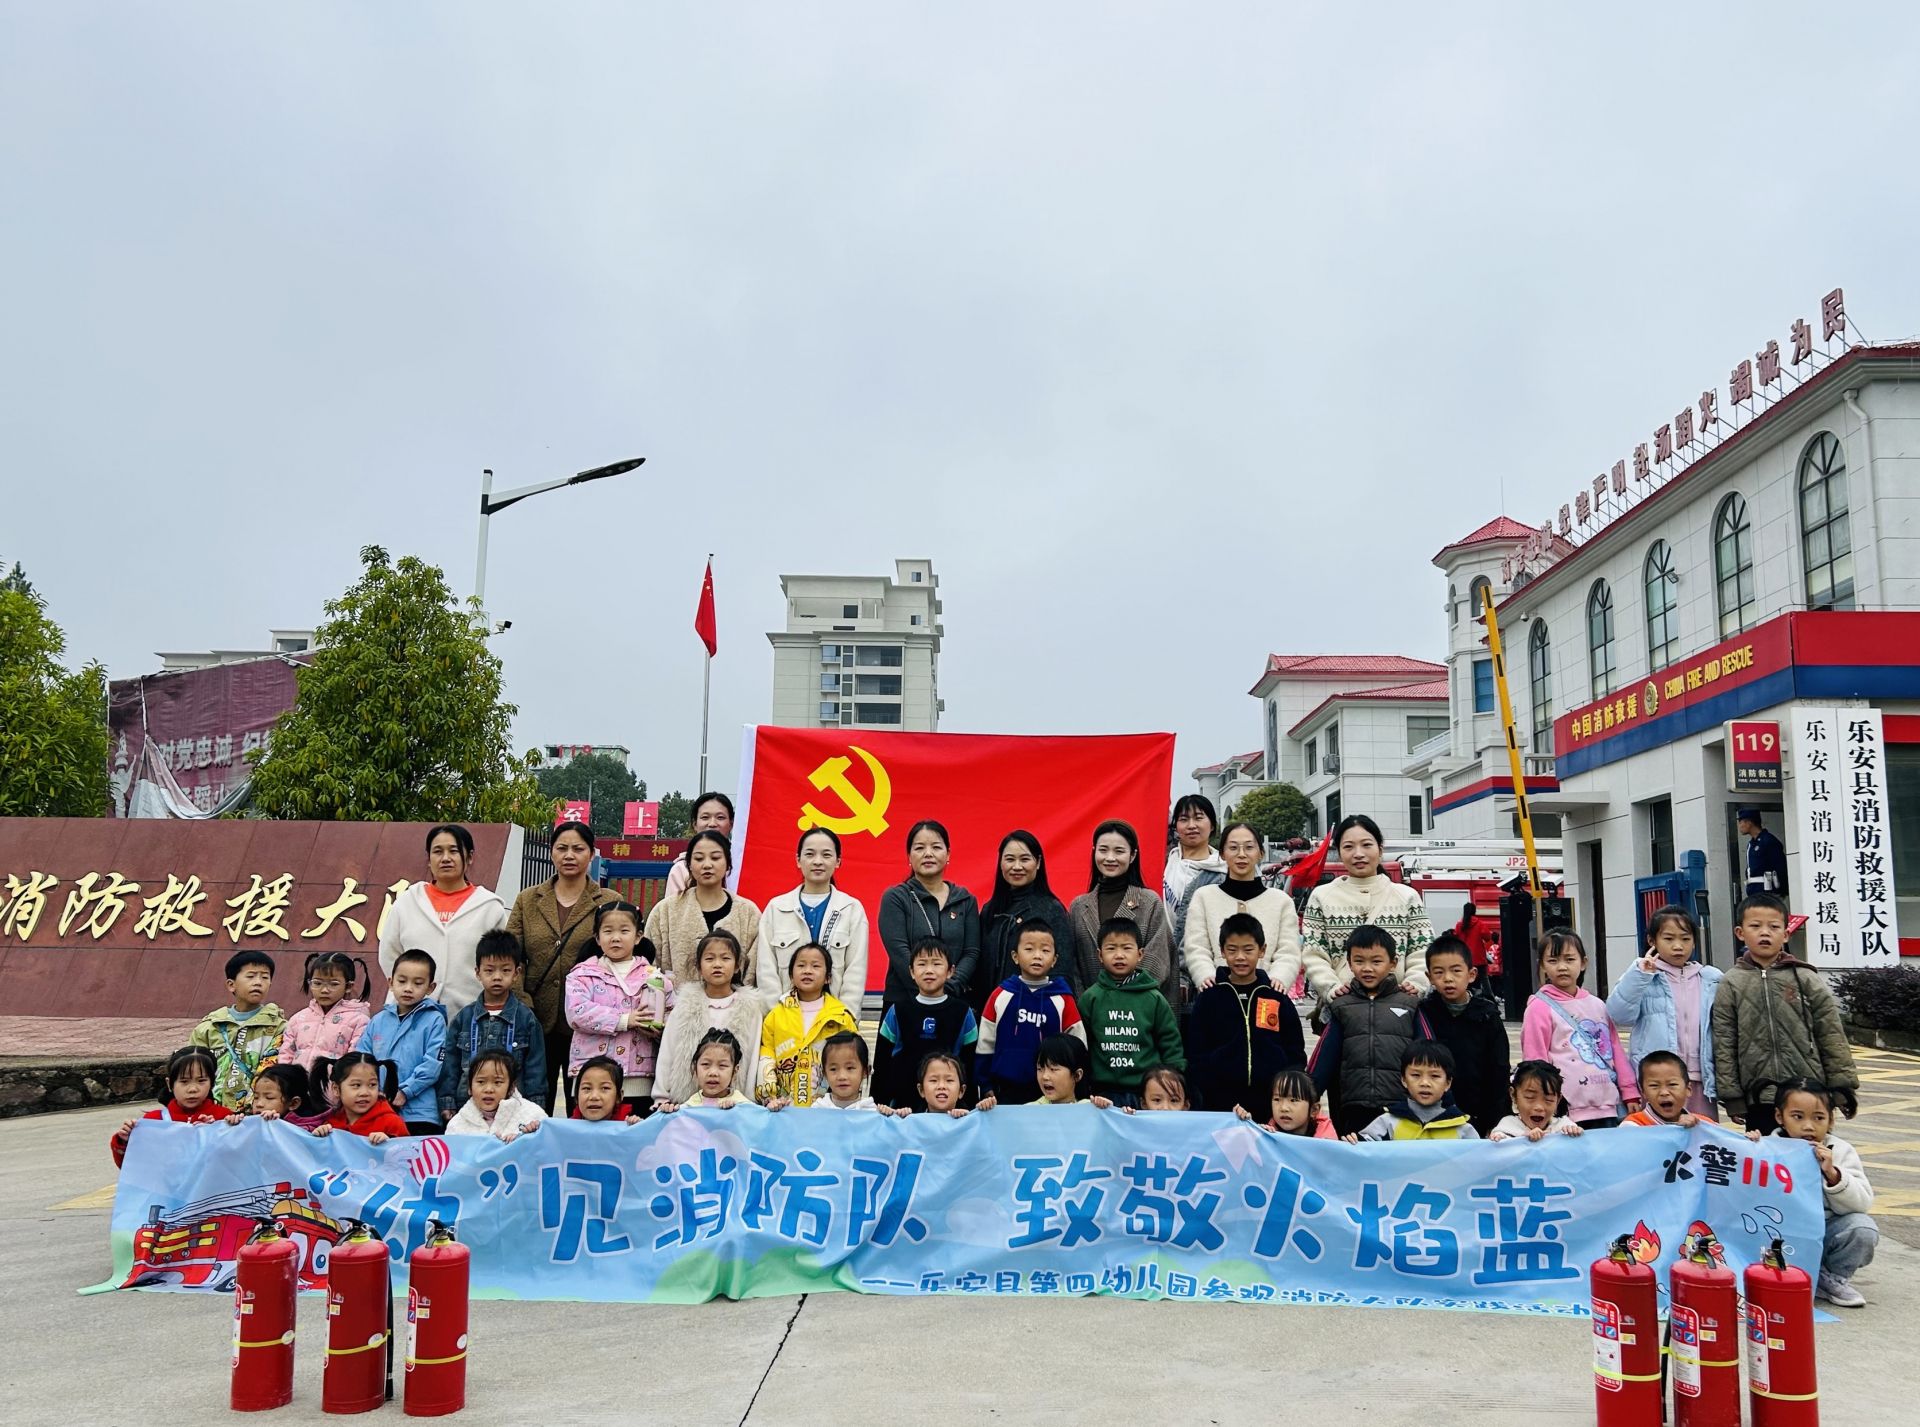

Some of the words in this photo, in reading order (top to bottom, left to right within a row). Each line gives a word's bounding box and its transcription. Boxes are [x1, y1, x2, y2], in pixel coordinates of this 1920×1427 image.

[1559, 473, 1626, 537] 纪律严明
[1633, 390, 1716, 482] 赴汤蹈火
[1729, 288, 1846, 406] 竭诚为民
[1664, 675, 1685, 700] CHINA
[1686, 666, 1703, 691] FIRE
[1704, 659, 1721, 684] AND
[1721, 644, 1754, 674] RESCUE
[1571, 692, 1638, 741] 中国消防救援
[1735, 732, 1775, 752] 119
[1738, 768, 1777, 779] 消防救援
[629, 806, 652, 829] 上
[1805, 720, 1841, 957] 乐安县消防救援局
[1847, 719, 1892, 957] 乐安县消防救援大队
[612, 843, 670, 857] 精神
[1506, 857, 1528, 867] JP2
[1018, 1009, 1047, 1027] Sup
[1108, 1010, 1135, 1021] W-I-A
[1104, 1026, 1139, 1037] MILANO
[1110, 1057, 1135, 1068] 2034
[798, 1072, 809, 1104] DUCK
[1663, 1144, 1793, 1194] 火警119
[1008, 1153, 1581, 1284] 致敬火焰蓝
